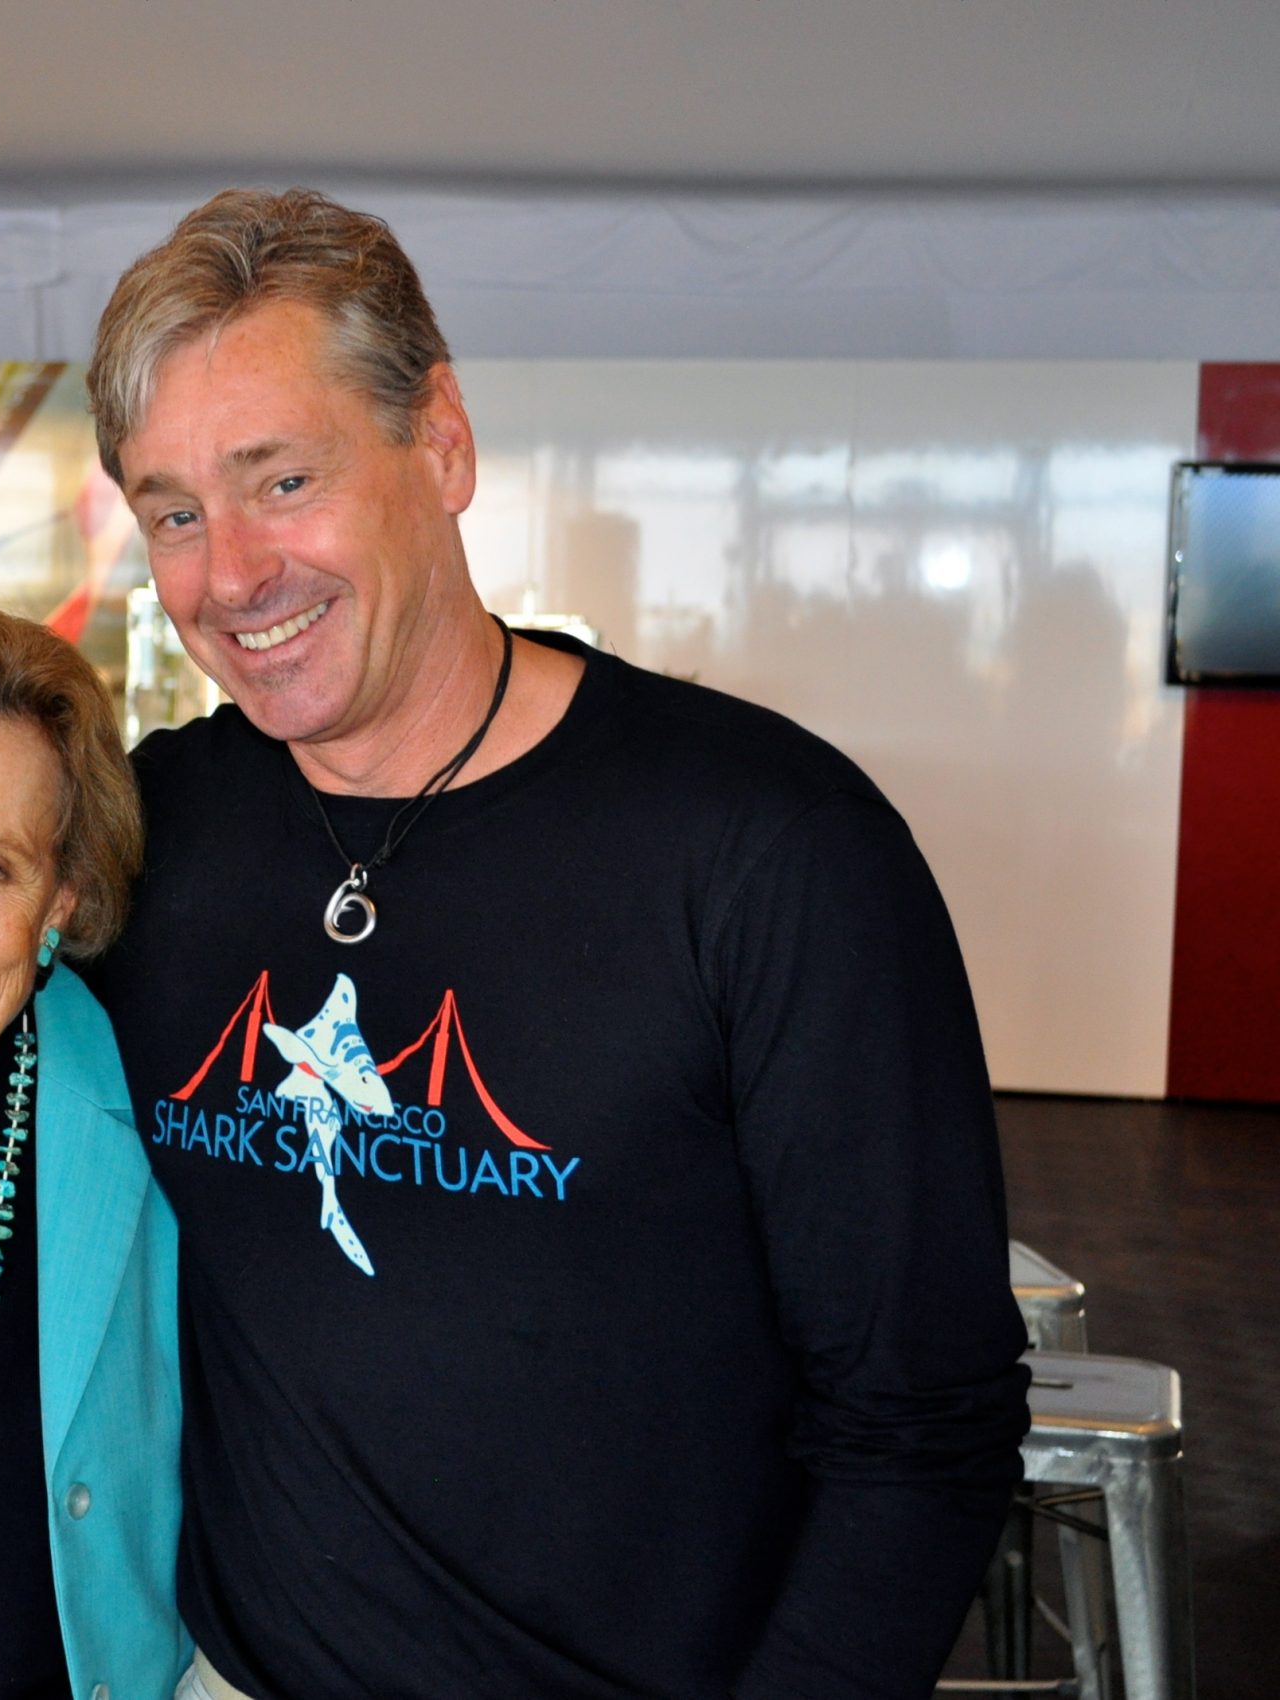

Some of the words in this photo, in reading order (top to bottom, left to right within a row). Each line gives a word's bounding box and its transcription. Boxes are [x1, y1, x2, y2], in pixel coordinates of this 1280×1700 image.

[236, 1086, 286, 1120] SAN
[152, 1100, 263, 1166] SHARK
[274, 1125, 581, 1200] SANCTUARY
